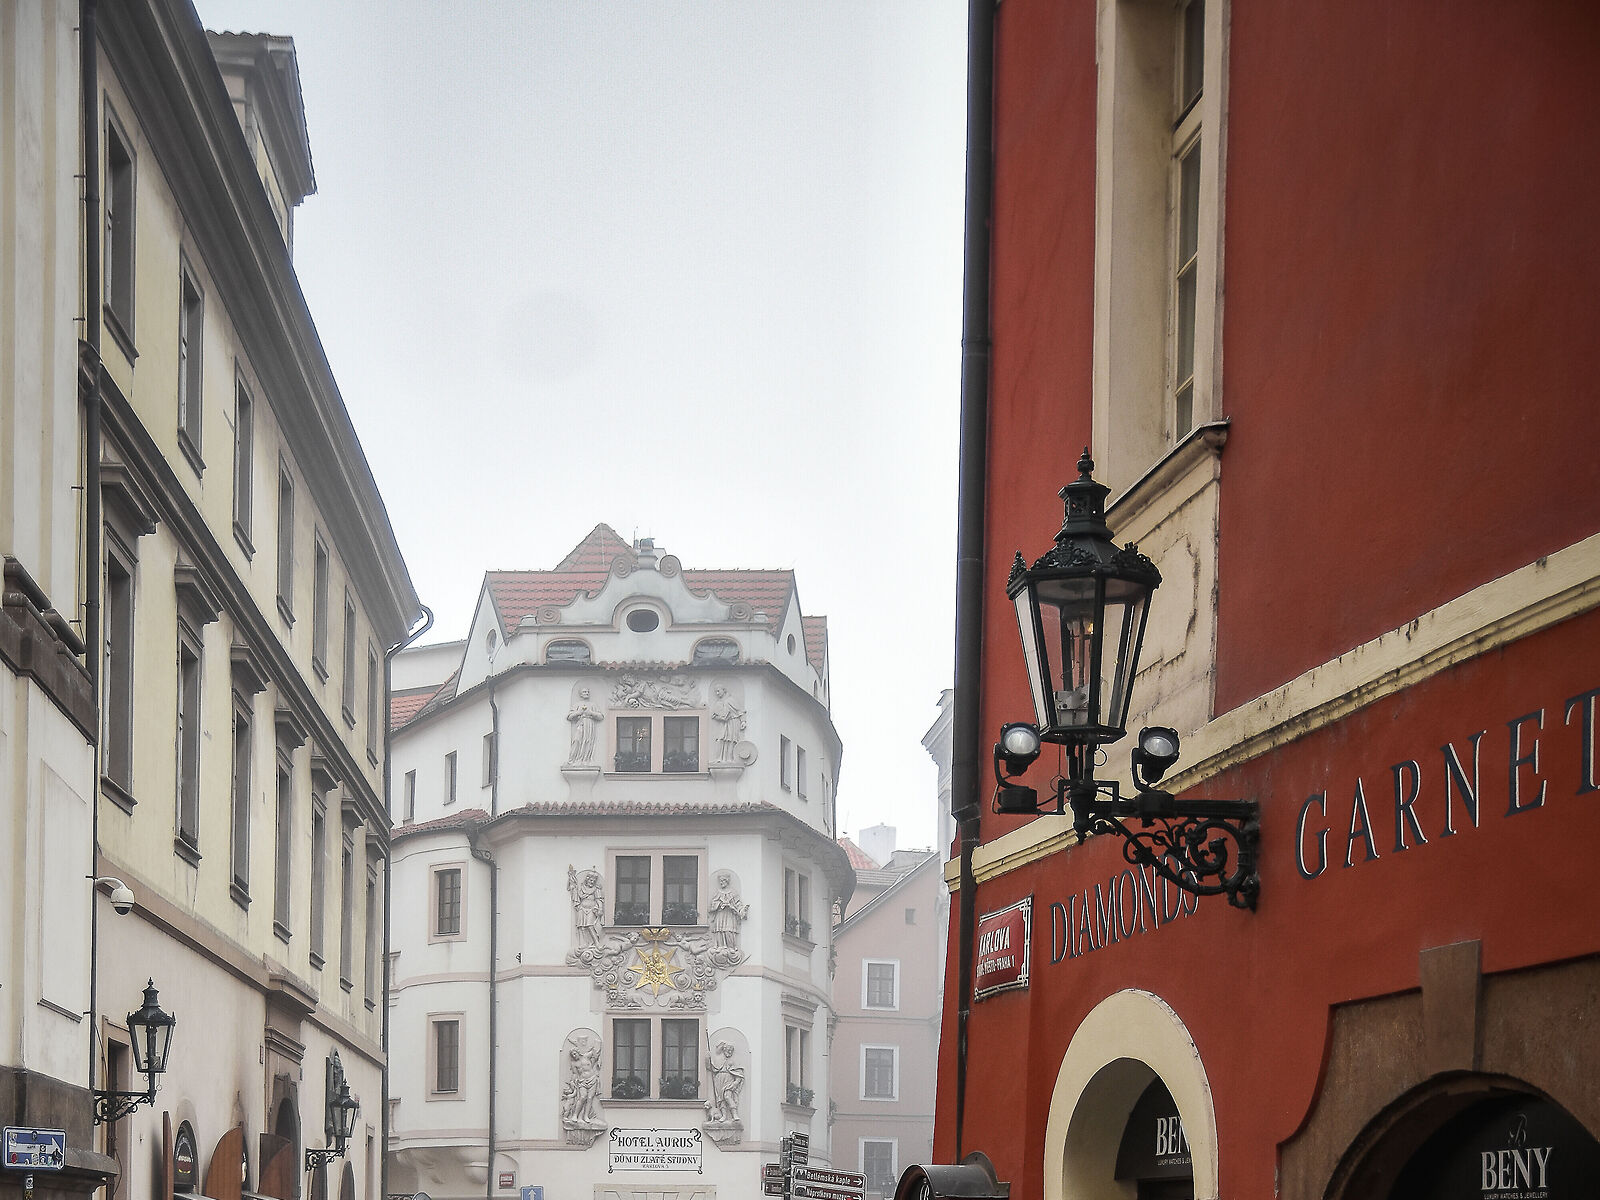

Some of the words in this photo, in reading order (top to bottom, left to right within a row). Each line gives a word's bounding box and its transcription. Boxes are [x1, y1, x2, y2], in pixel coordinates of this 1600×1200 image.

[1295, 687, 1600, 881] GARNET
[1050, 846, 1200, 965] DIAMONDS
[618, 1136, 653, 1147] HOTEL
[655, 1136, 694, 1148] AURUS
[1156, 1116, 1190, 1156] BEN
[633, 1155, 639, 1163] U
[640, 1154, 666, 1164] ZLATÉ
[667, 1156, 698, 1164] STUDNY
[1481, 1147, 1553, 1191] BENY
